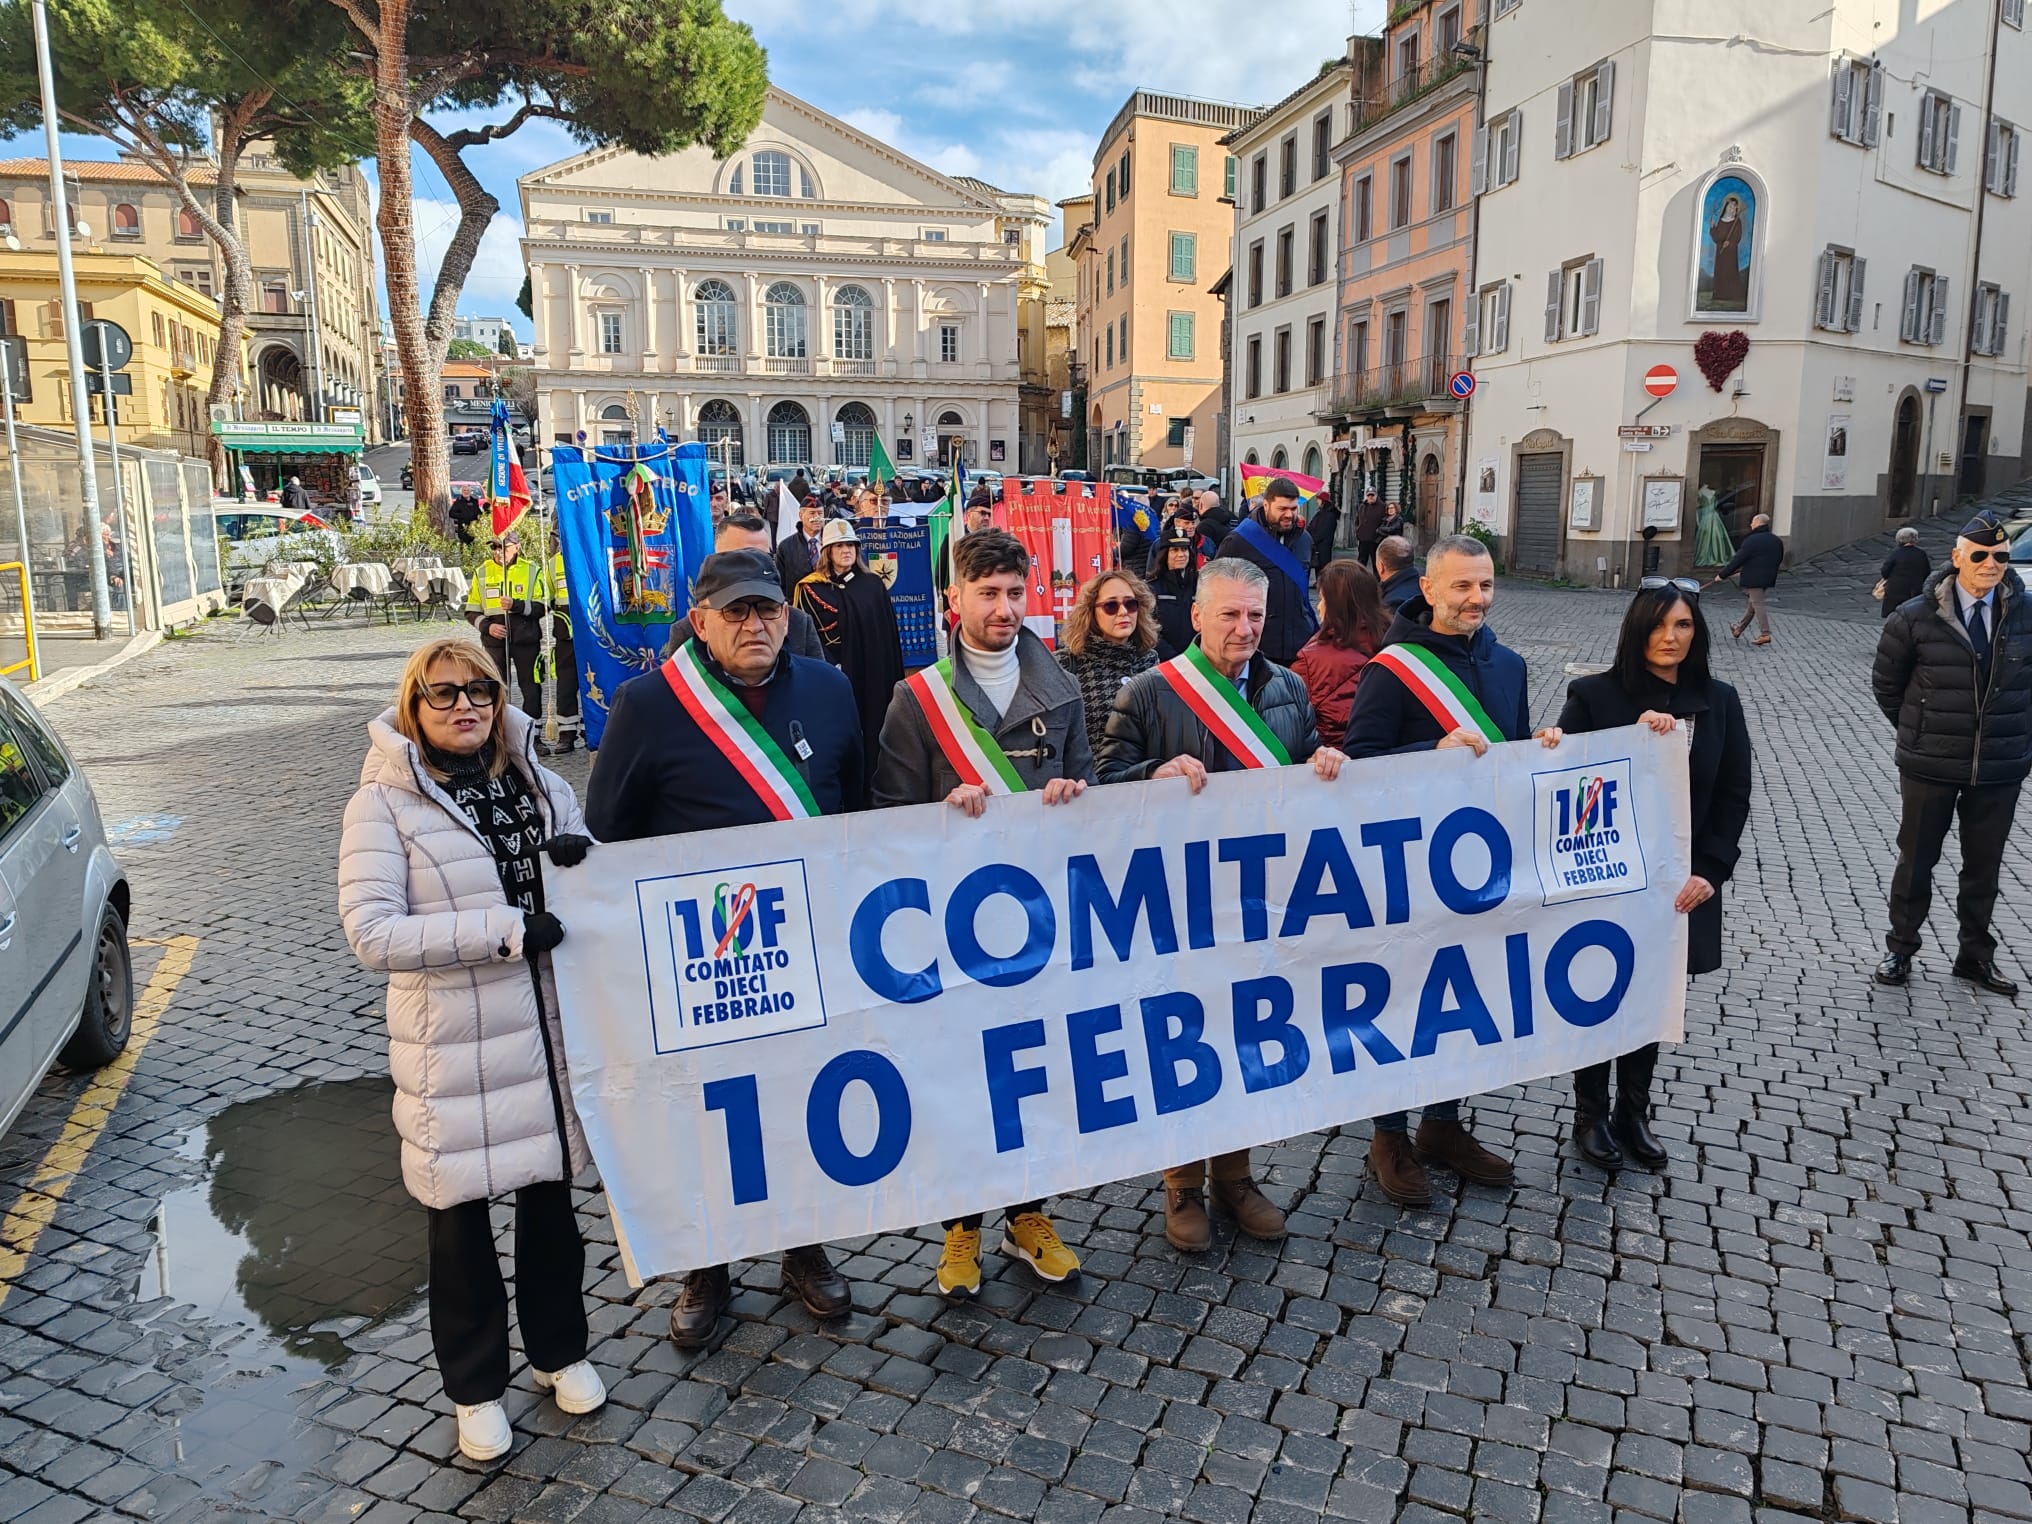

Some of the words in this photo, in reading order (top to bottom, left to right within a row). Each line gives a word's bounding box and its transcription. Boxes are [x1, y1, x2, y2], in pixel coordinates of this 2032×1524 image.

[497, 462, 506, 487] SEZIONE
[567, 479, 613, 501] CITTA'
[861, 541, 891, 551] UFFICIALI
[893, 540, 921, 550] D'ITALIA
[890, 530, 926, 540] NAZIONALE
[890, 593, 927, 603] NAZIONALE
[1556, 829, 1620, 853] COMITATO
[1574, 847, 1609, 867] DIECI
[1563, 862, 1628, 886] FEBBRAIO
[850, 807, 1512, 1004] COMITATO
[685, 950, 789, 982] COMITATO
[714, 974, 767, 1000] DIECI
[692, 991, 795, 1026] FEBBRAIO
[704, 1050, 911, 1206] 10
[982, 920, 1634, 1153] FEBBRAIO
